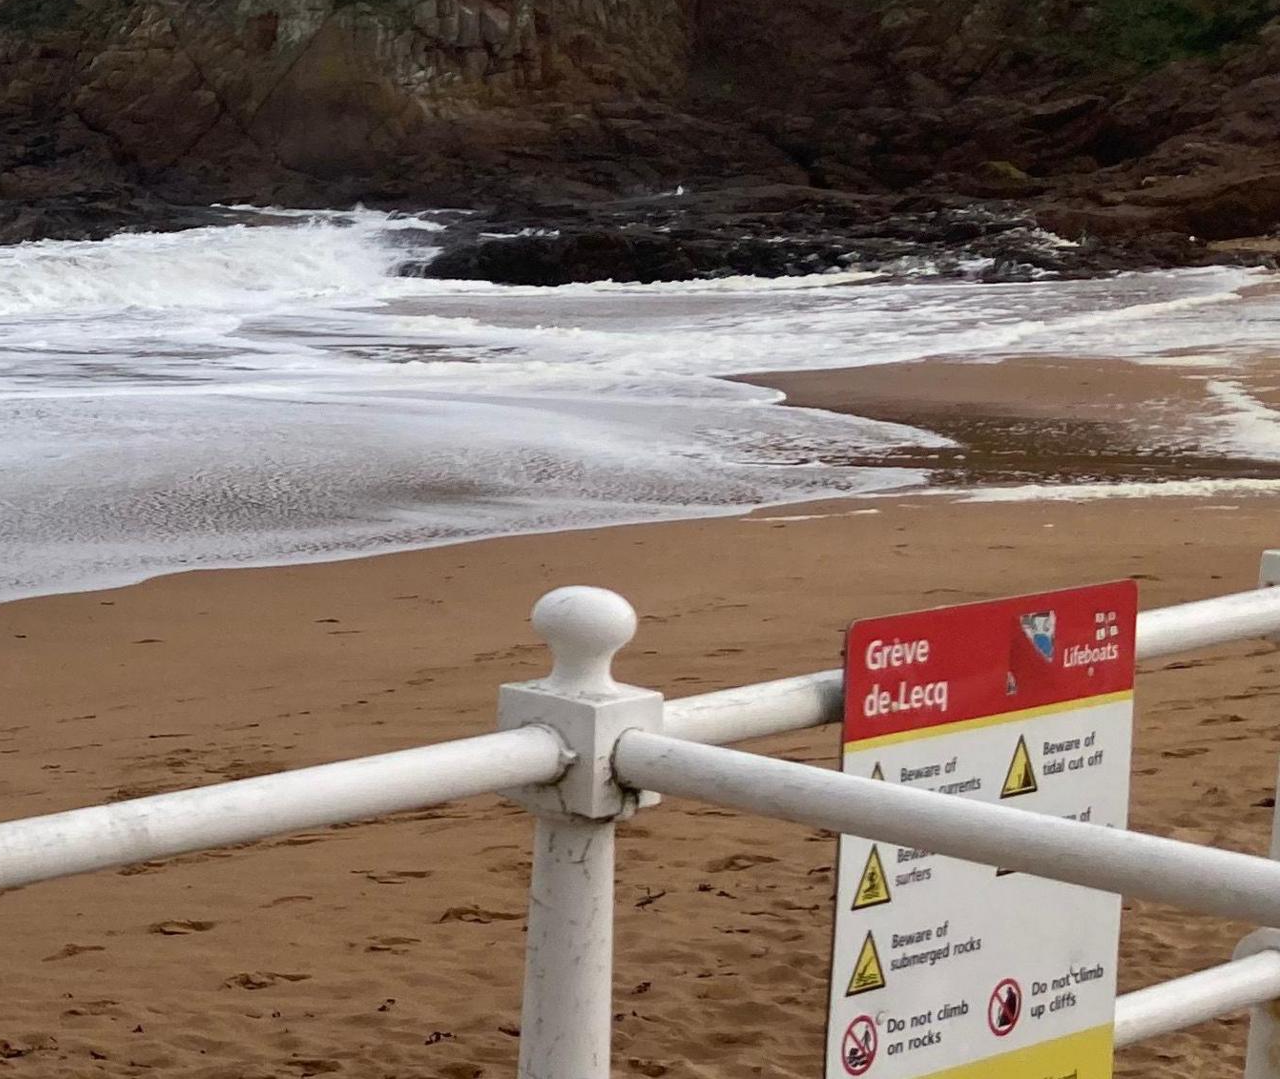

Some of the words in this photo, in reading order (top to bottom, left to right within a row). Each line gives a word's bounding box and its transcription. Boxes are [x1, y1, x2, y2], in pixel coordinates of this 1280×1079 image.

[865, 638, 929, 670] Grève
[1063, 642, 1119, 668] Lifeboats
[864, 684, 891, 717] de
[898, 681, 949, 712] Lecq
[1043, 738, 1081, 756] Beware
[1084, 731, 1096, 747] of
[901, 764, 941, 783] Beware
[945, 756, 958, 773] of
[1043, 758, 1065, 775] tidal
[1068, 756, 1084, 770] cut
[1087, 750, 1104, 766] off
[1080, 806, 1092, 822] of
[896, 867, 932, 887] surfers
[891, 929, 933, 949] Beware
[936, 920, 949, 938] of
[890, 942, 951, 971] submerged
[953, 936, 982, 956] rocks
[1031, 981, 1048, 996] Do
[1051, 973, 1072, 990] not
[1075, 964, 1104, 983] climb
[887, 1018, 906, 1034] Do
[910, 1010, 933, 1028] not
[937, 1000, 969, 1021] climb
[1030, 1004, 1045, 1019] up
[1049, 991, 1077, 1013] cliffs
[887, 1042, 905, 1056] on
[908, 1030, 942, 1050] rocks
